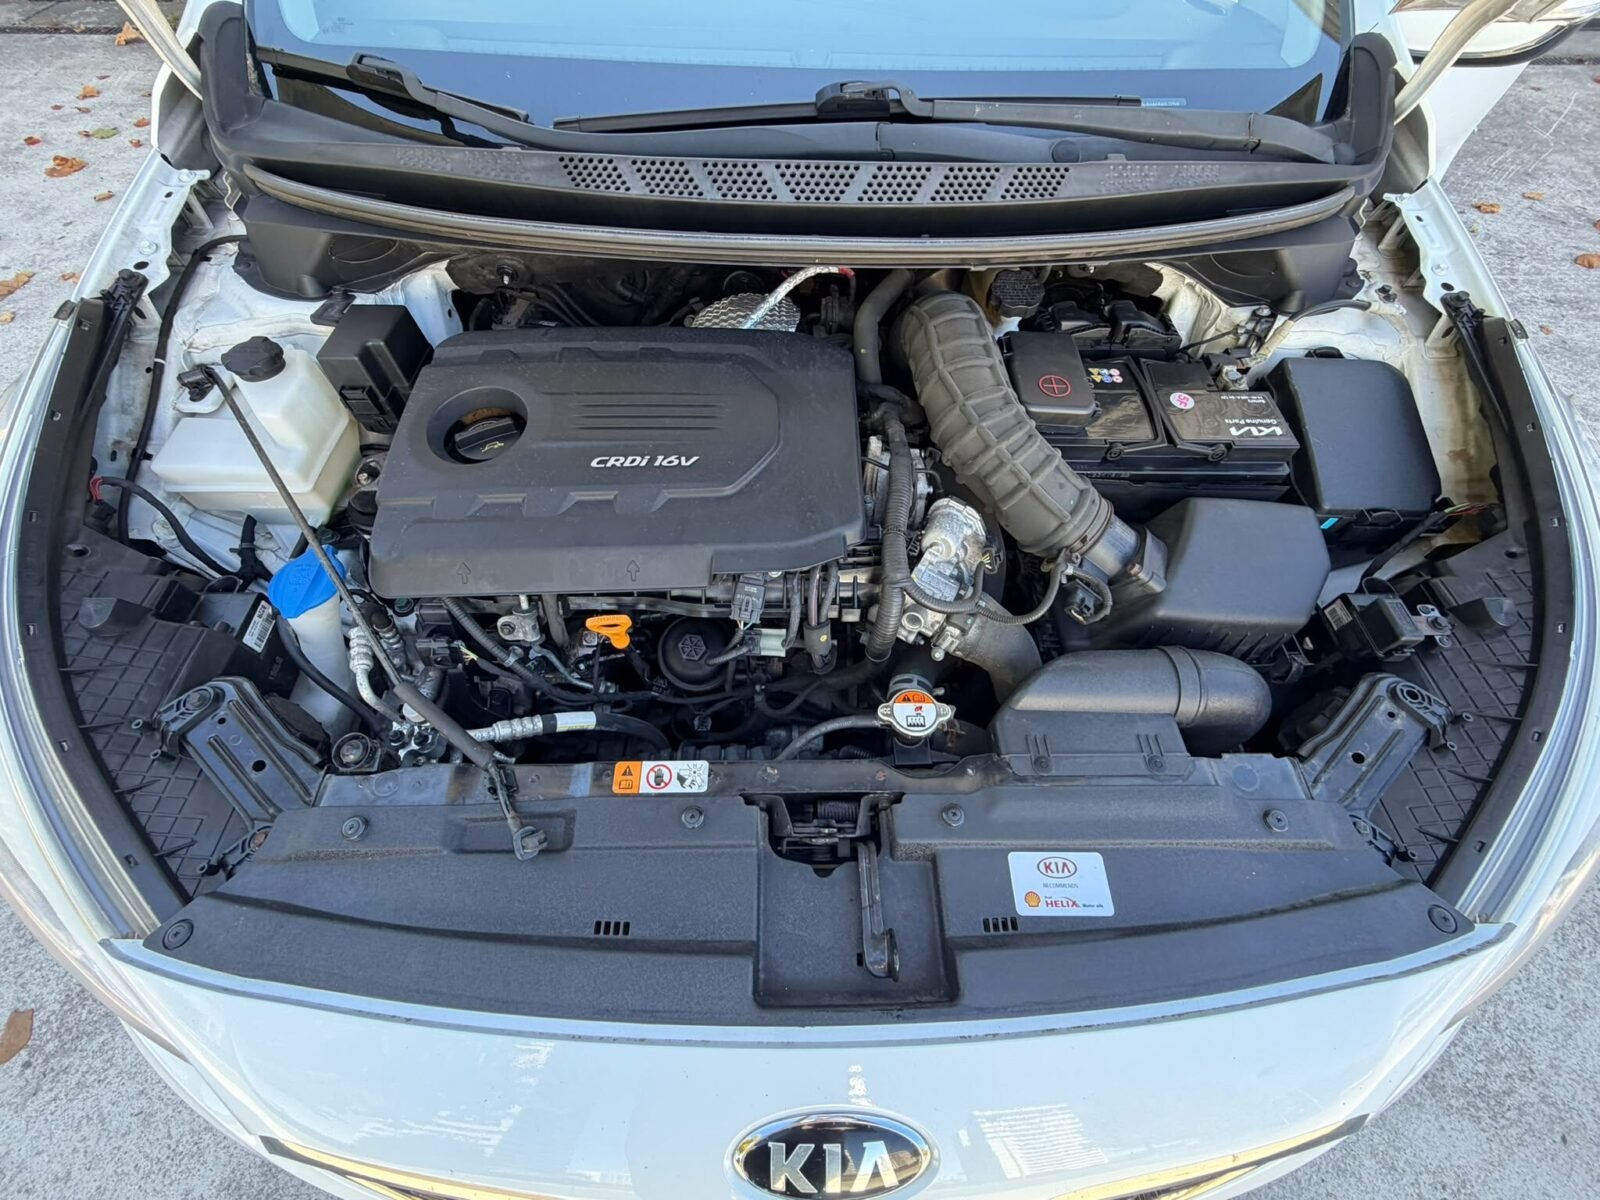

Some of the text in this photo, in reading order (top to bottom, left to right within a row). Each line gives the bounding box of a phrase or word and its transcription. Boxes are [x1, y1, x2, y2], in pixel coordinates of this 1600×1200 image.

[1229, 426, 1283, 436] KIA
[590, 455, 700, 468] CRDi 16V
[1043, 861, 1072, 874] KIA
[1045, 899, 1080, 908] HELIX
[767, 1140, 900, 1194] KIA
